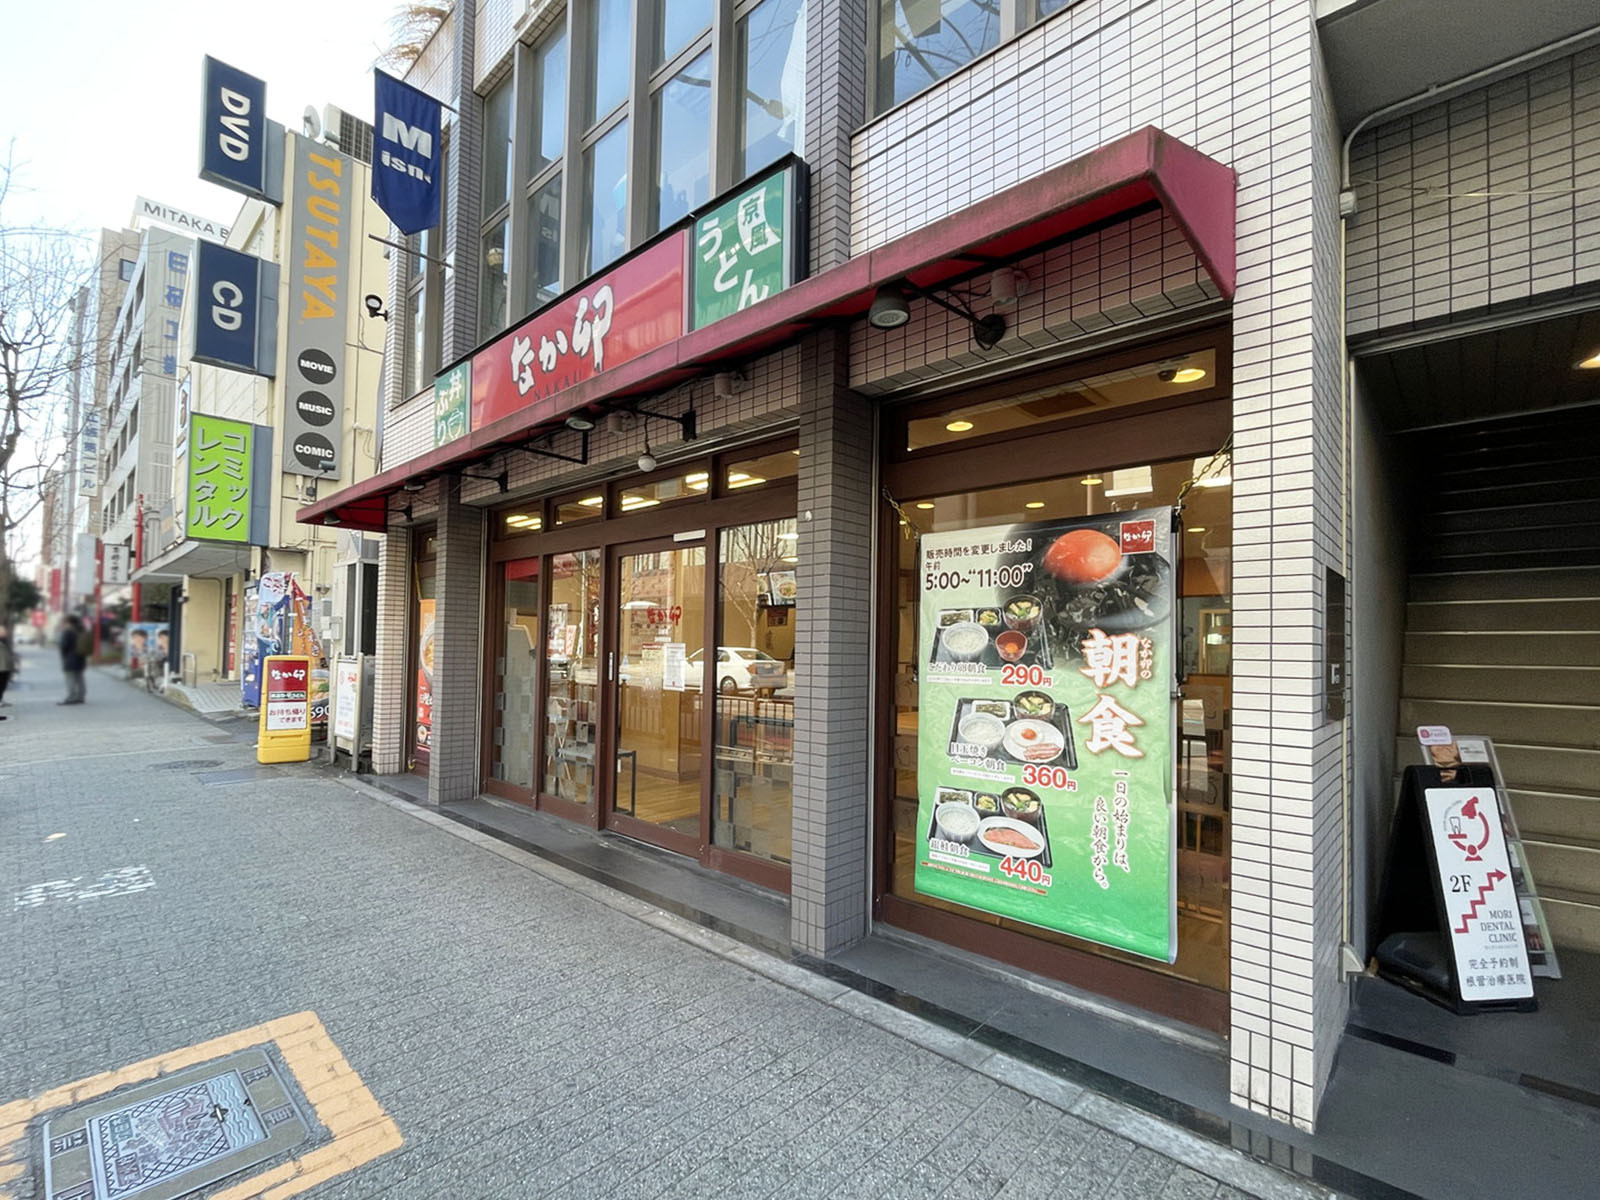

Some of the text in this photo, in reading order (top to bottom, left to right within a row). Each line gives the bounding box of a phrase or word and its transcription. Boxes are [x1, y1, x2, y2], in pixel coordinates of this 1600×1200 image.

[219, 87, 250, 161] DVD
[382, 112, 432, 159] M
[144, 203, 215, 235] MITAKA
[303, 152, 342, 320] TSUTAYA
[699, 217, 770, 312] うどん
[212, 280, 243, 331] CD
[510, 284, 614, 396] なか卯
[300, 359, 334, 374] MOVIE
[298, 401, 333, 416] MUSIC
[295, 443, 334, 458] COMIC
[193, 427, 222, 528] レンタル
[221, 432, 248, 530] コミック
[1001, 666, 1052, 687] 290円
[1078, 629, 1146, 757] 朝食
[1023, 765, 1077, 791] 360円
[1113, 771, 1129, 872] 一日の始まりは、
[1092, 796, 1108, 888] 良い朝食から。
[1000, 857, 1052, 886] 440円
[1449, 874, 1472, 893] 2F
[1480, 922, 1515, 932] DENTAL
[1488, 910, 1513, 919] MORI
[1488, 933, 1518, 943] CLINIC
